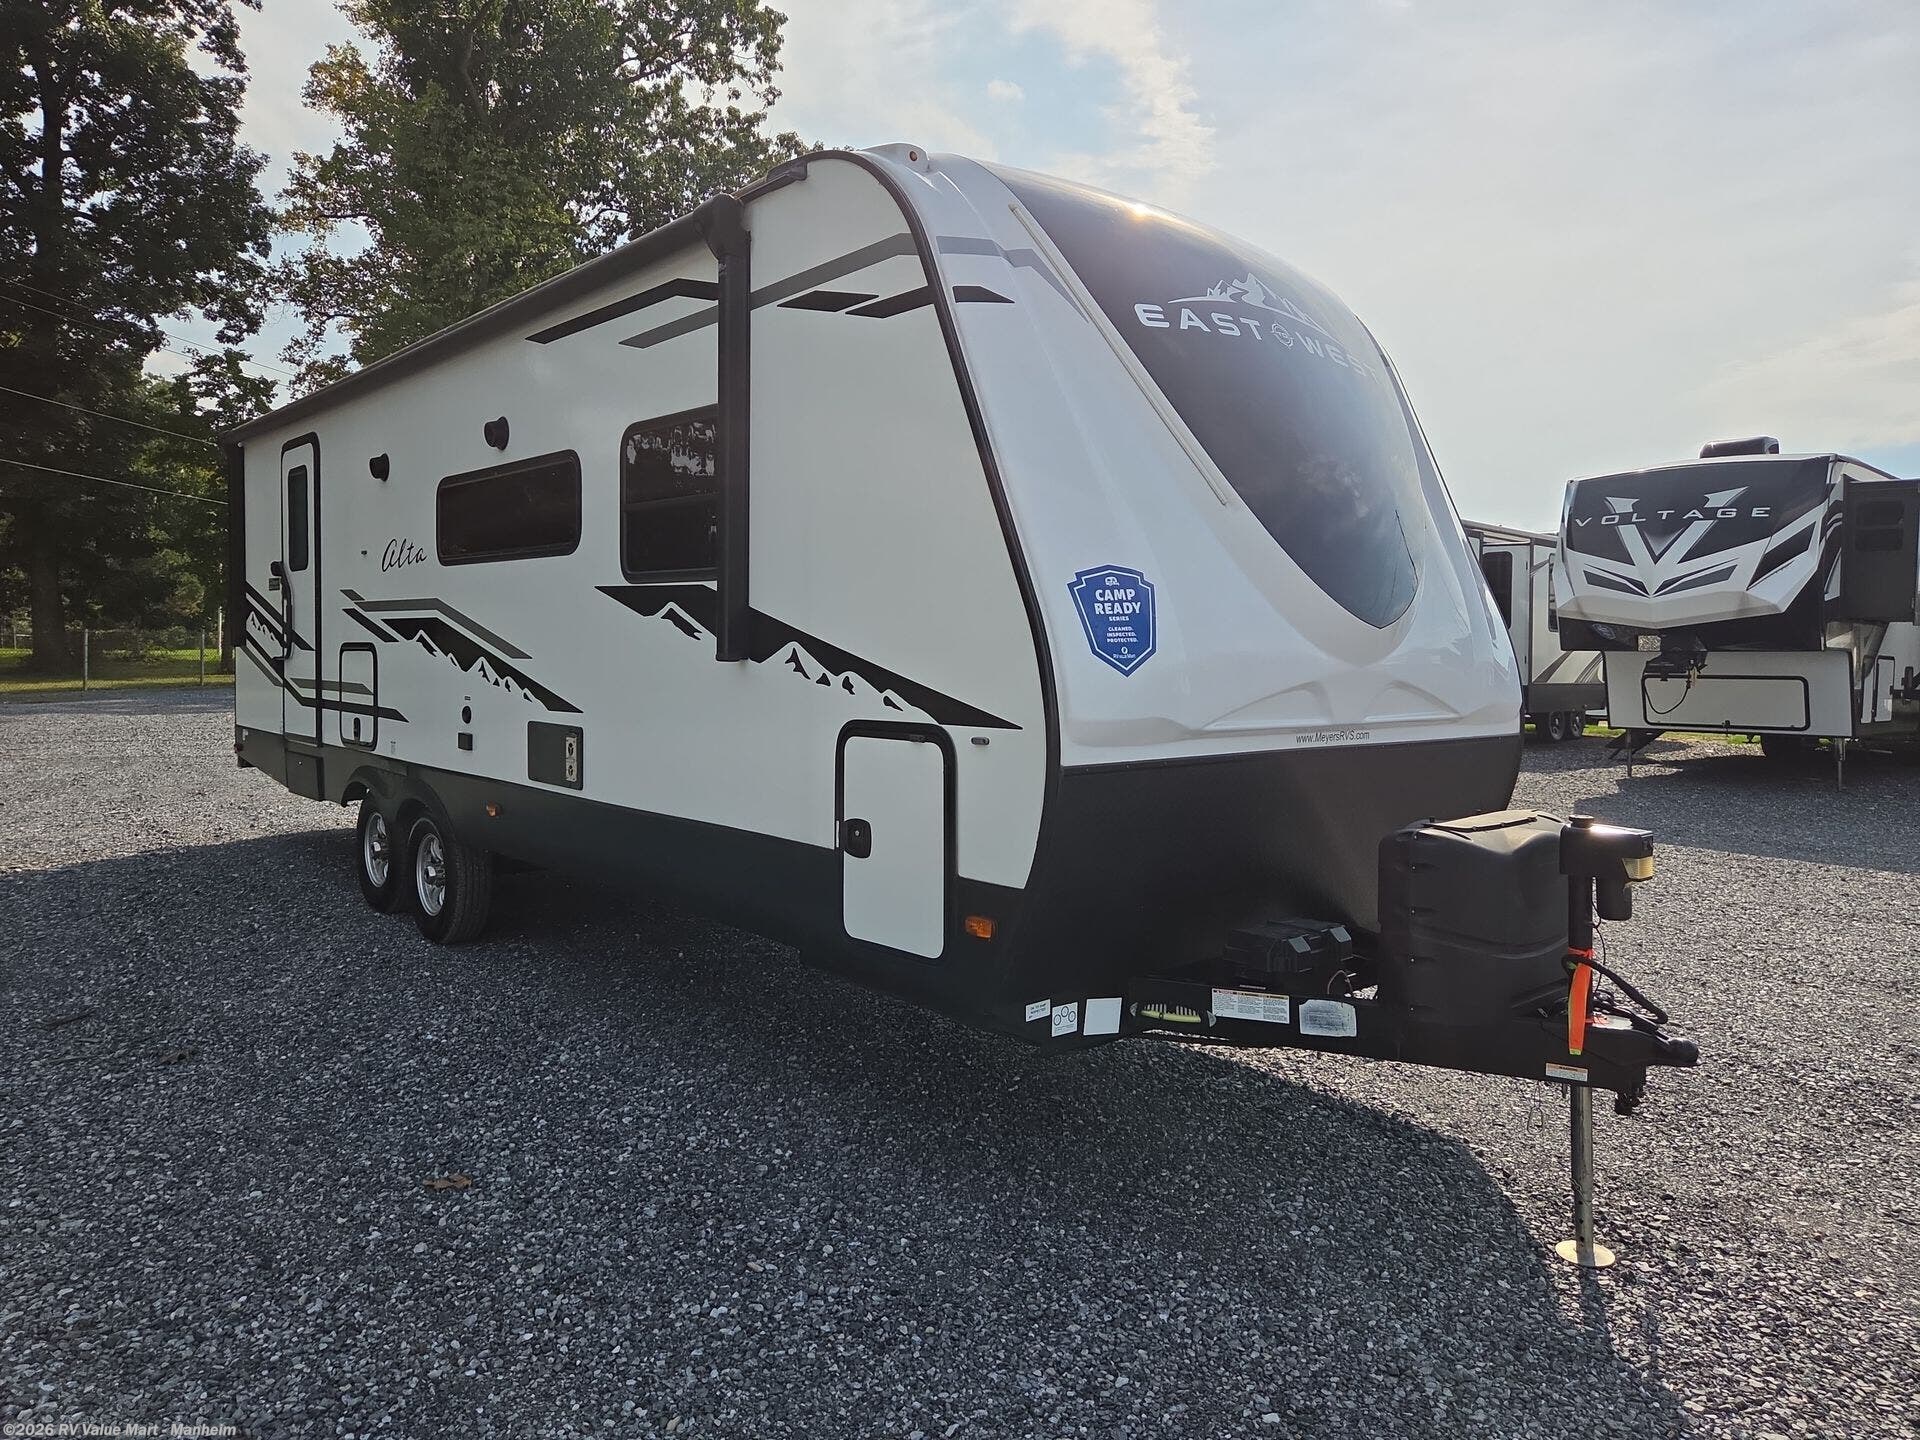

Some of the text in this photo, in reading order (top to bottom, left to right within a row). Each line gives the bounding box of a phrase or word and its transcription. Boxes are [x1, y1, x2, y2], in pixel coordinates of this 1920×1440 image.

[1134, 303, 1380, 385] EAST WEST
[1575, 507, 1771, 527] VOLTAGE
[382, 538, 428, 572] Alta
[1095, 588, 1136, 601] CAMP
[1093, 602, 1142, 615] READY
[1295, 729, 1370, 744] www.MeyersRVS.com
